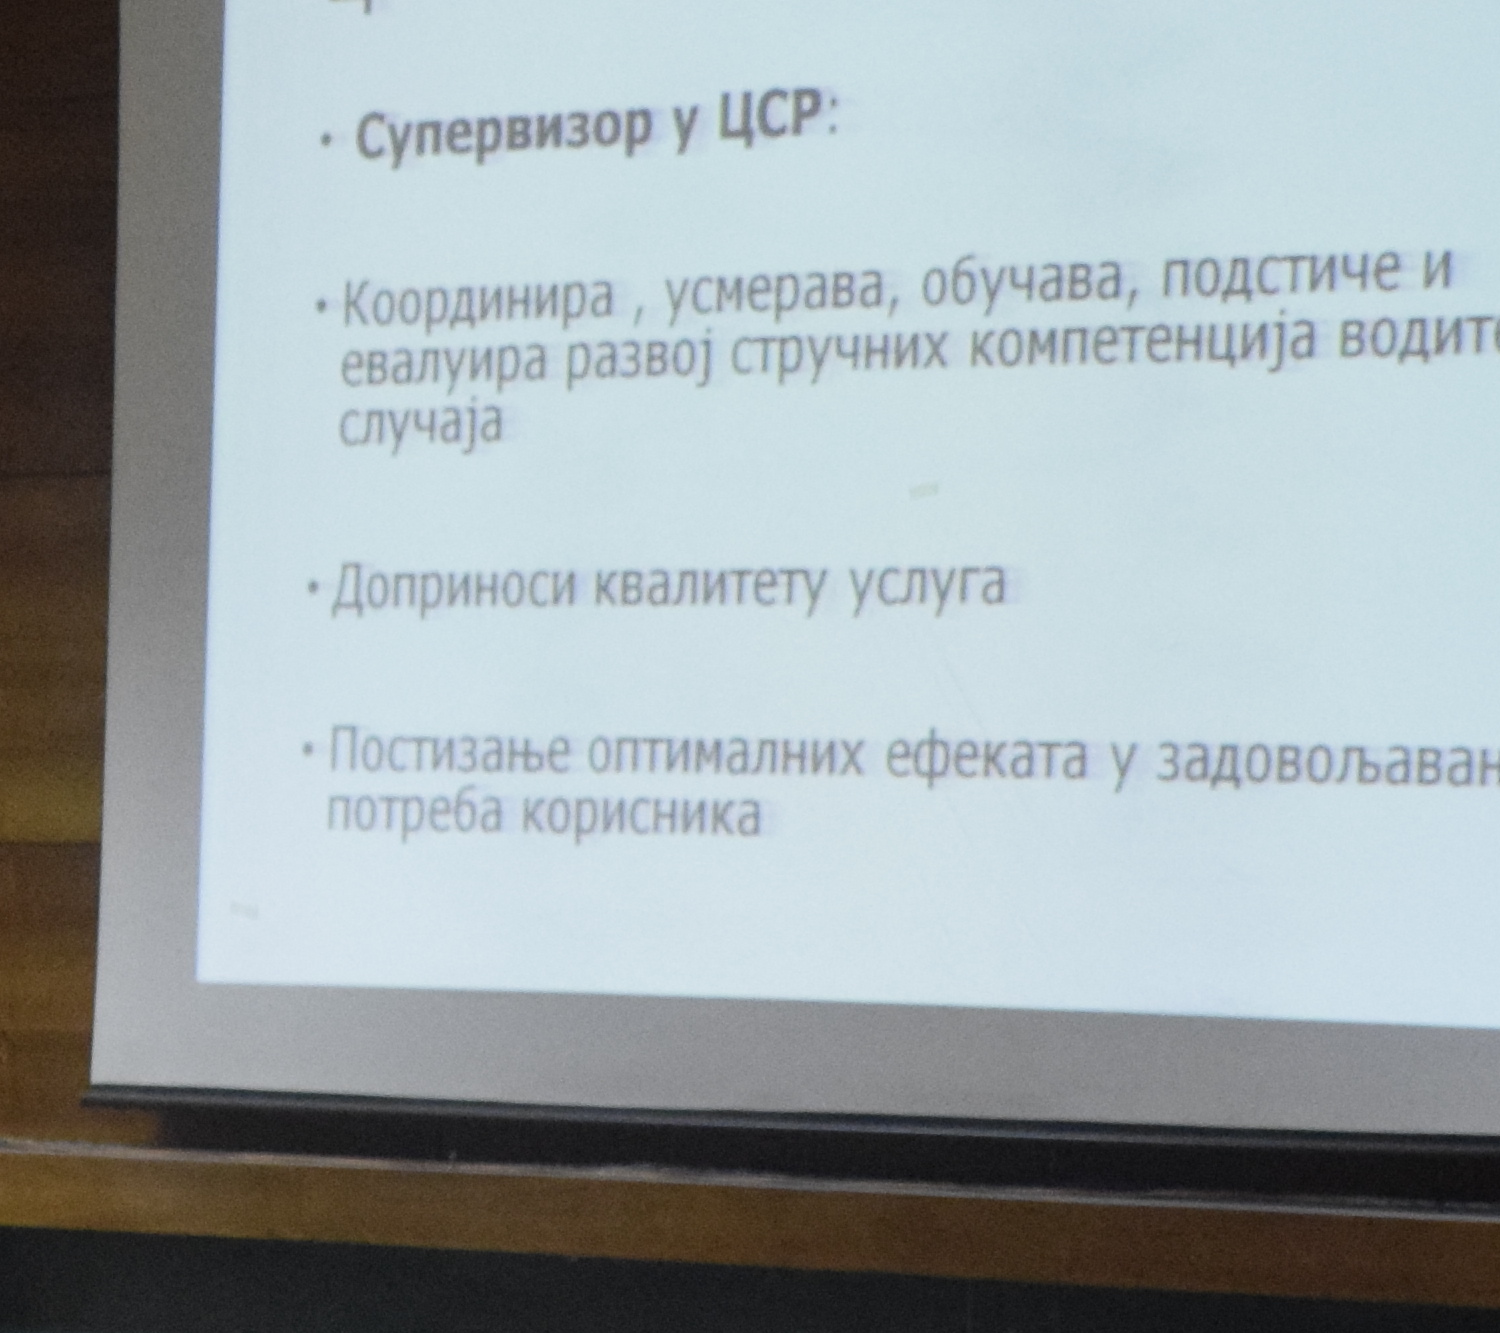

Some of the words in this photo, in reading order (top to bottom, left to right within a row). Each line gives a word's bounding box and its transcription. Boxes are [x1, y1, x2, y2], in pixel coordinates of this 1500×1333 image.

[356, 107, 653, 169] Супервизор
[673, 104, 700, 154] у
[719, 86, 839, 149] ЦСР:
[343, 280, 614, 334] Координира
[665, 268, 900, 323] усмерава,
[921, 254, 1140, 316] обучава,
[1162, 250, 1402, 304] подстиче
[1423, 250, 1454, 289] и
[341, 341, 548, 395] евалуира
[566, 328, 714, 390] развој
[731, 330, 950, 384] стручних
[970, 309, 1317, 373] компетенција
[339, 398, 504, 456] случаја
[330, 562, 578, 619] Доприноси
[594, 567, 828, 618] квалитету
[849, 565, 1007, 618] услуга
[329, 725, 573, 775] Постизање
[588, 736, 865, 777] оптималних
[886, 728, 1089, 790] ефеката
[1110, 742, 1139, 793] у
[327, 785, 505, 844] потреба
[522, 796, 763, 846] корисника
